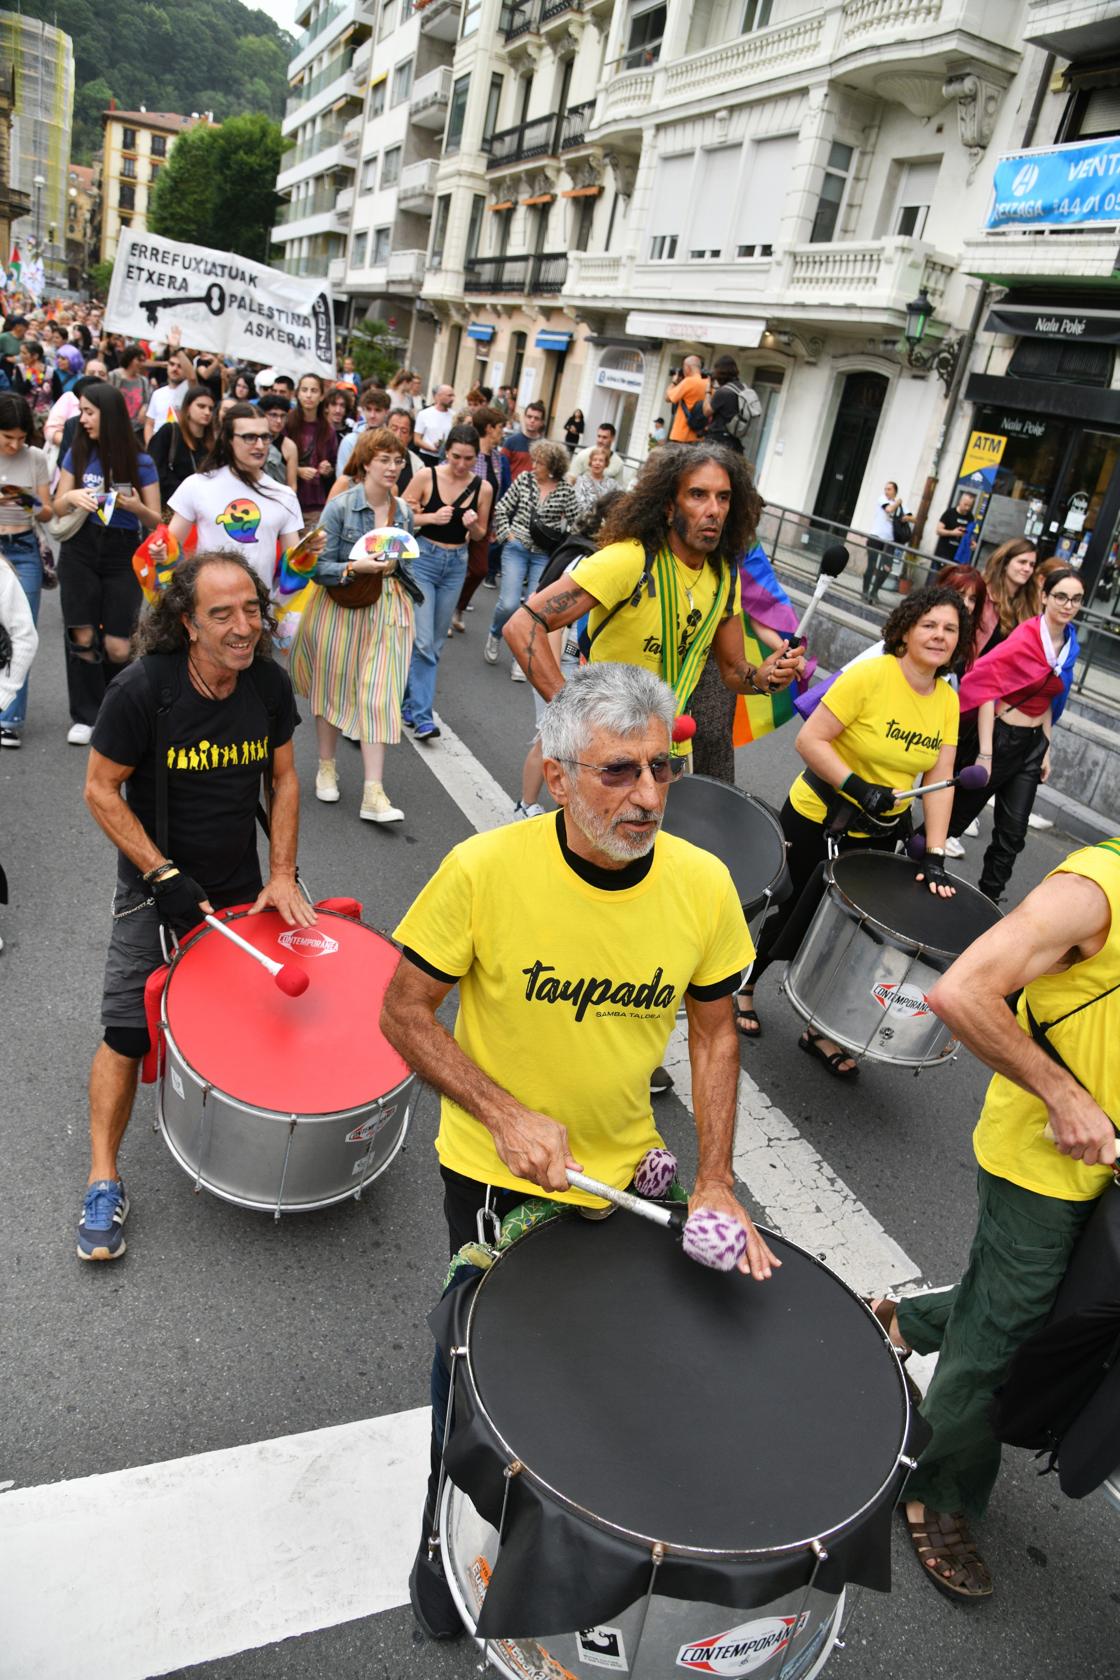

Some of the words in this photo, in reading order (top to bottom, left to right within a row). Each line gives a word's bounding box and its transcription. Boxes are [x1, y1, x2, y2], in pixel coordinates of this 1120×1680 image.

[126, 264, 189, 293] ETXERA
[130, 242, 259, 288] ERREFUXIATUAK
[228, 294, 312, 328] PALESTINA
[243, 321, 312, 350] ASKERA!
[1035, 317, 1060, 332] Nalu
[1060, 318, 1087, 336] Poké
[1001, 417, 1023, 432] Nalu
[973, 436, 1002, 454] ATM
[522, 959, 676, 1022] taupada
[595, 1010, 627, 1019] SAMBA
